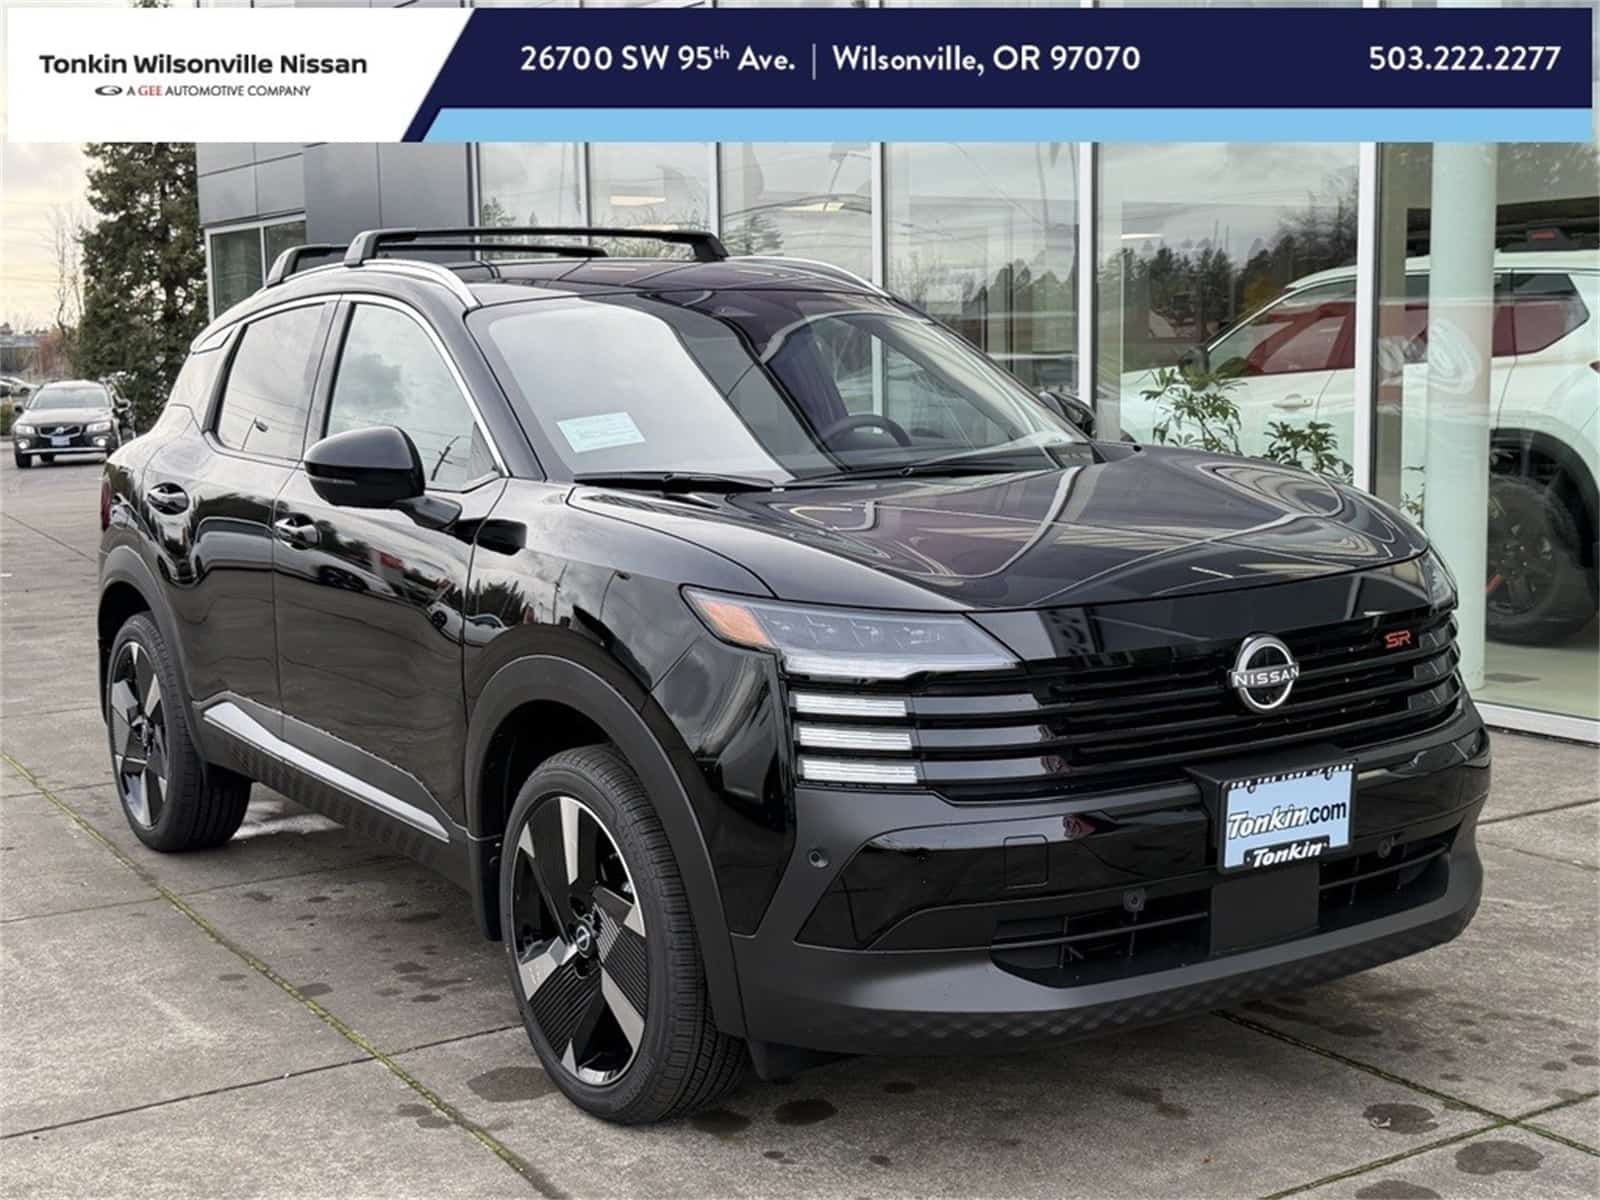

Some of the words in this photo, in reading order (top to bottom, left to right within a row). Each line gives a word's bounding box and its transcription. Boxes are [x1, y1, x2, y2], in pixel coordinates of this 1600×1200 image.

[1384, 629, 1412, 649] SR
[1233, 666, 1299, 687] NISSAN
[1227, 801, 1347, 840] Tonkin.com
[1252, 841, 1323, 869] Tonkin
